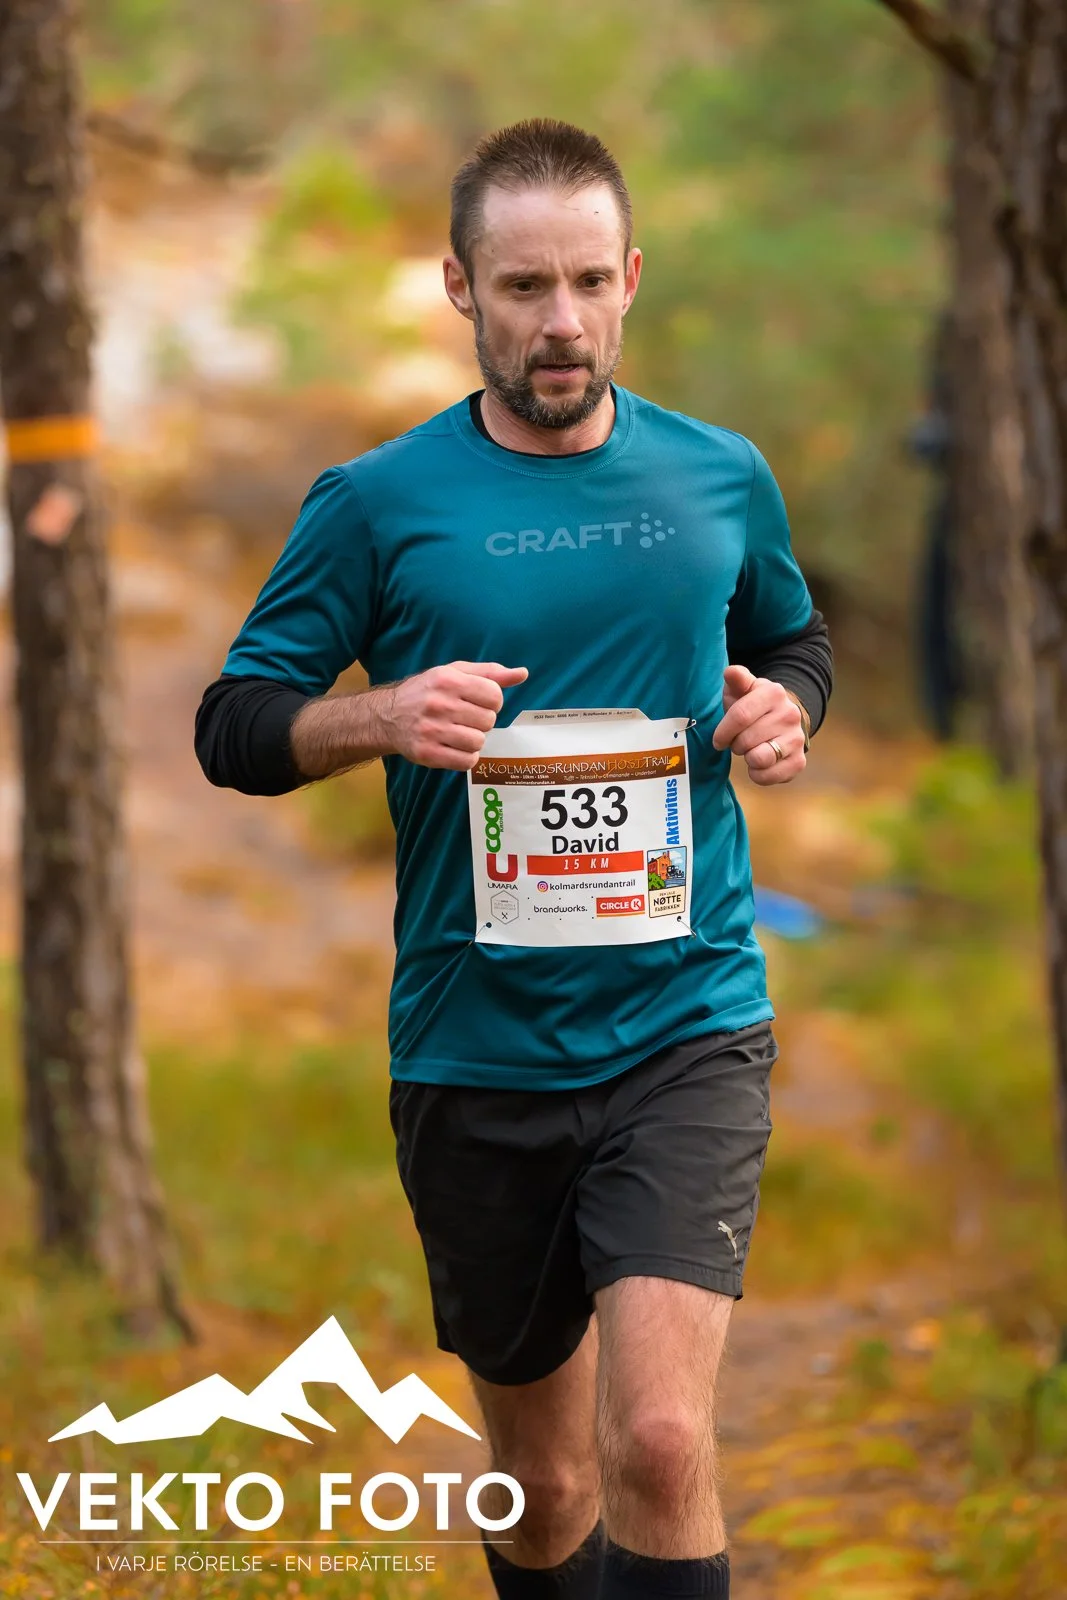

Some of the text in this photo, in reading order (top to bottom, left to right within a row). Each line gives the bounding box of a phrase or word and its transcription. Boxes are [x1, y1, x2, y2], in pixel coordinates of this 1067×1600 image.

[485, 521, 632, 557] CRAFT
[541, 786, 628, 830] 533
[666, 779, 680, 845] Aktivitus
[483, 787, 502, 853] coop
[552, 832, 619, 854] David
[564, 858, 609, 870] 15 KM
[549, 879, 636, 891] kolmardsrundantrail
[533, 905, 588, 913] brandworks.
[600, 902, 629, 910] CIRCLE
[653, 895, 682, 906] NØTTE
